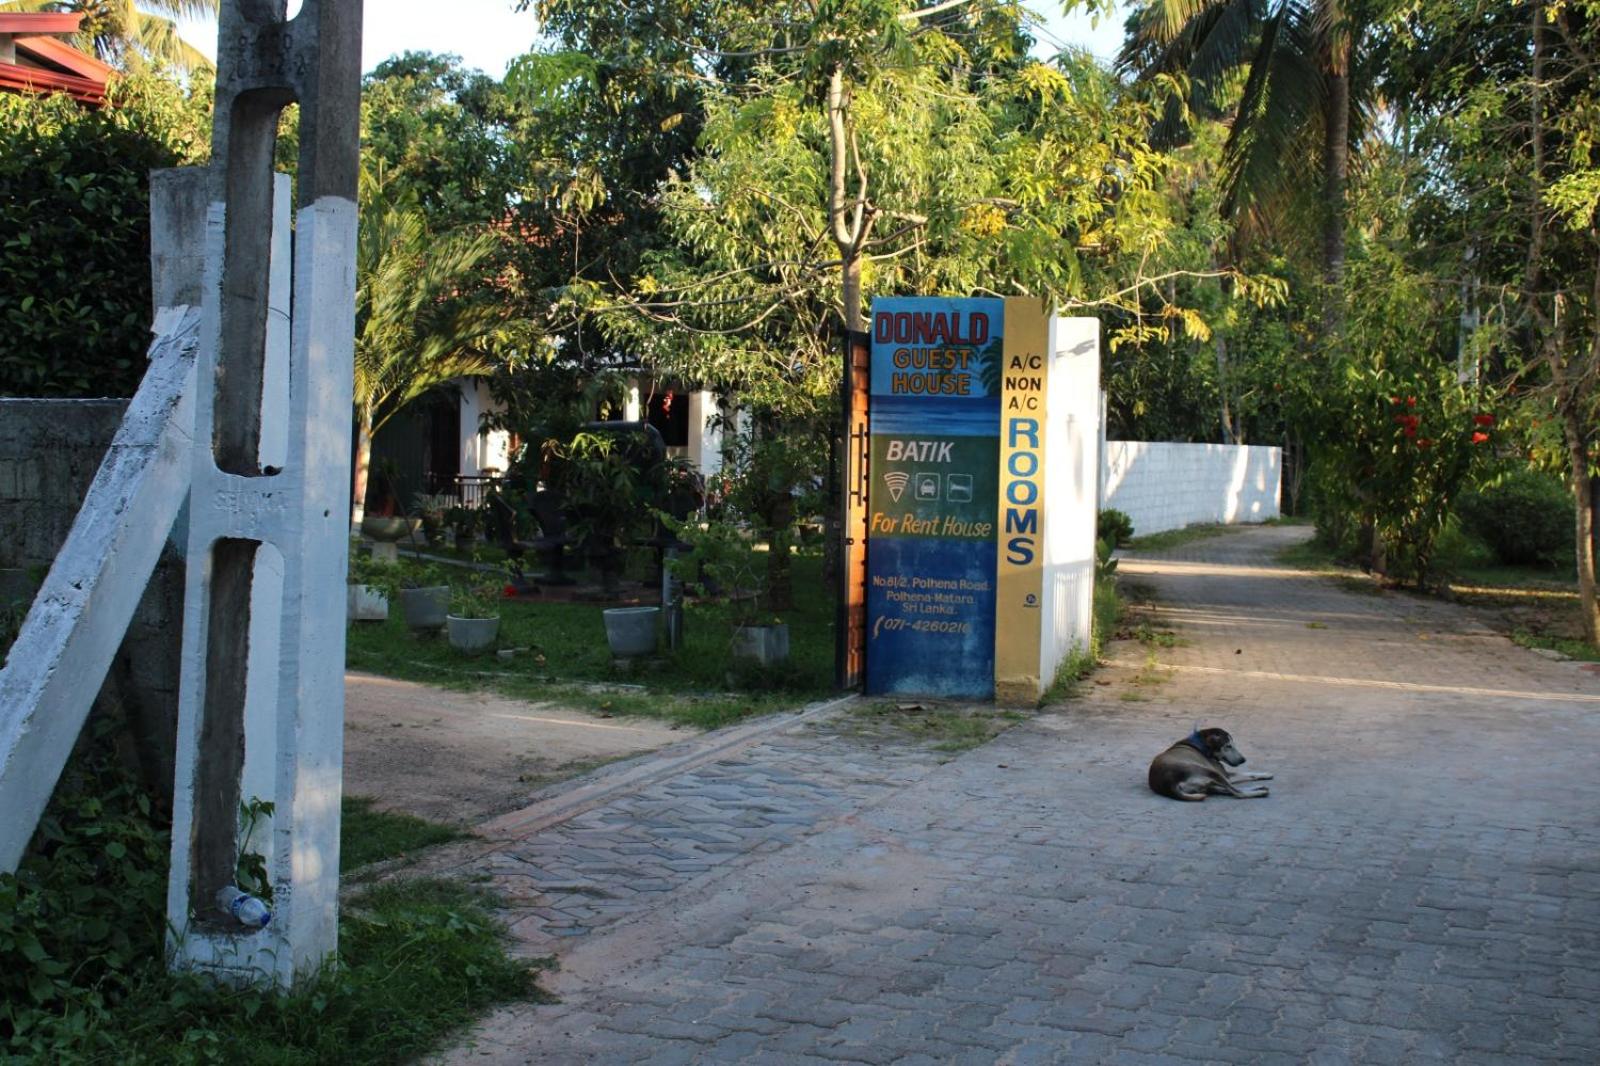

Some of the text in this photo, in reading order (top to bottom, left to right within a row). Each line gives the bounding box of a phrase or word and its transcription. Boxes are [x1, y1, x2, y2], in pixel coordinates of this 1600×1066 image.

[875, 312, 990, 345] DONALD
[893, 349, 971, 370] GUEST
[1010, 353, 1042, 373] A/C
[892, 373, 971, 395] HOUSE
[1006, 377, 1042, 391] NON
[1008, 394, 1039, 413] A/C
[886, 440, 954, 463] BATIK
[1005, 417, 1040, 566] ROOMS
[871, 512, 992, 537] For Rent House
[912, 577, 957, 590] Polhena
[902, 602, 917, 613] Sri
